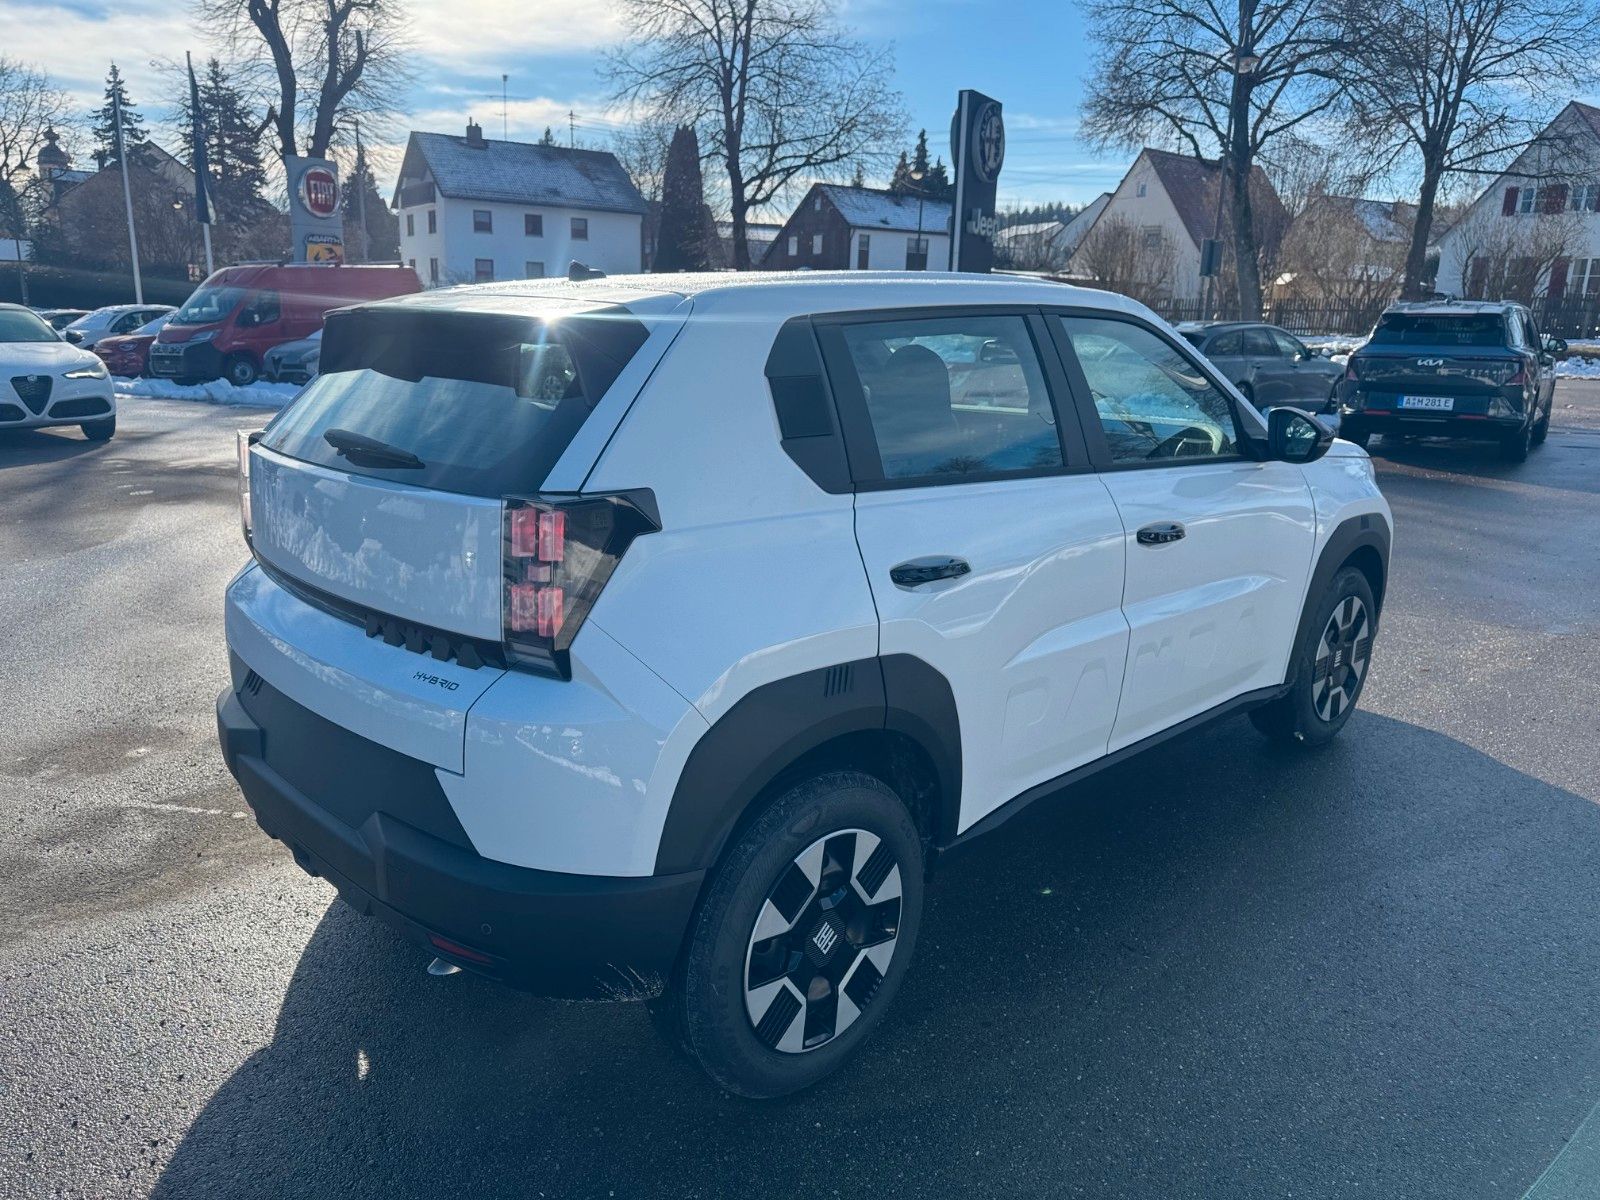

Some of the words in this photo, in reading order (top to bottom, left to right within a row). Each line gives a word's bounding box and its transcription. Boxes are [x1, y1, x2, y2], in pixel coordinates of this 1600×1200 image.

[310, 180, 335, 206] FIAT
[967, 208, 1000, 242] Jeep
[412, 671, 460, 691] HYBRID
